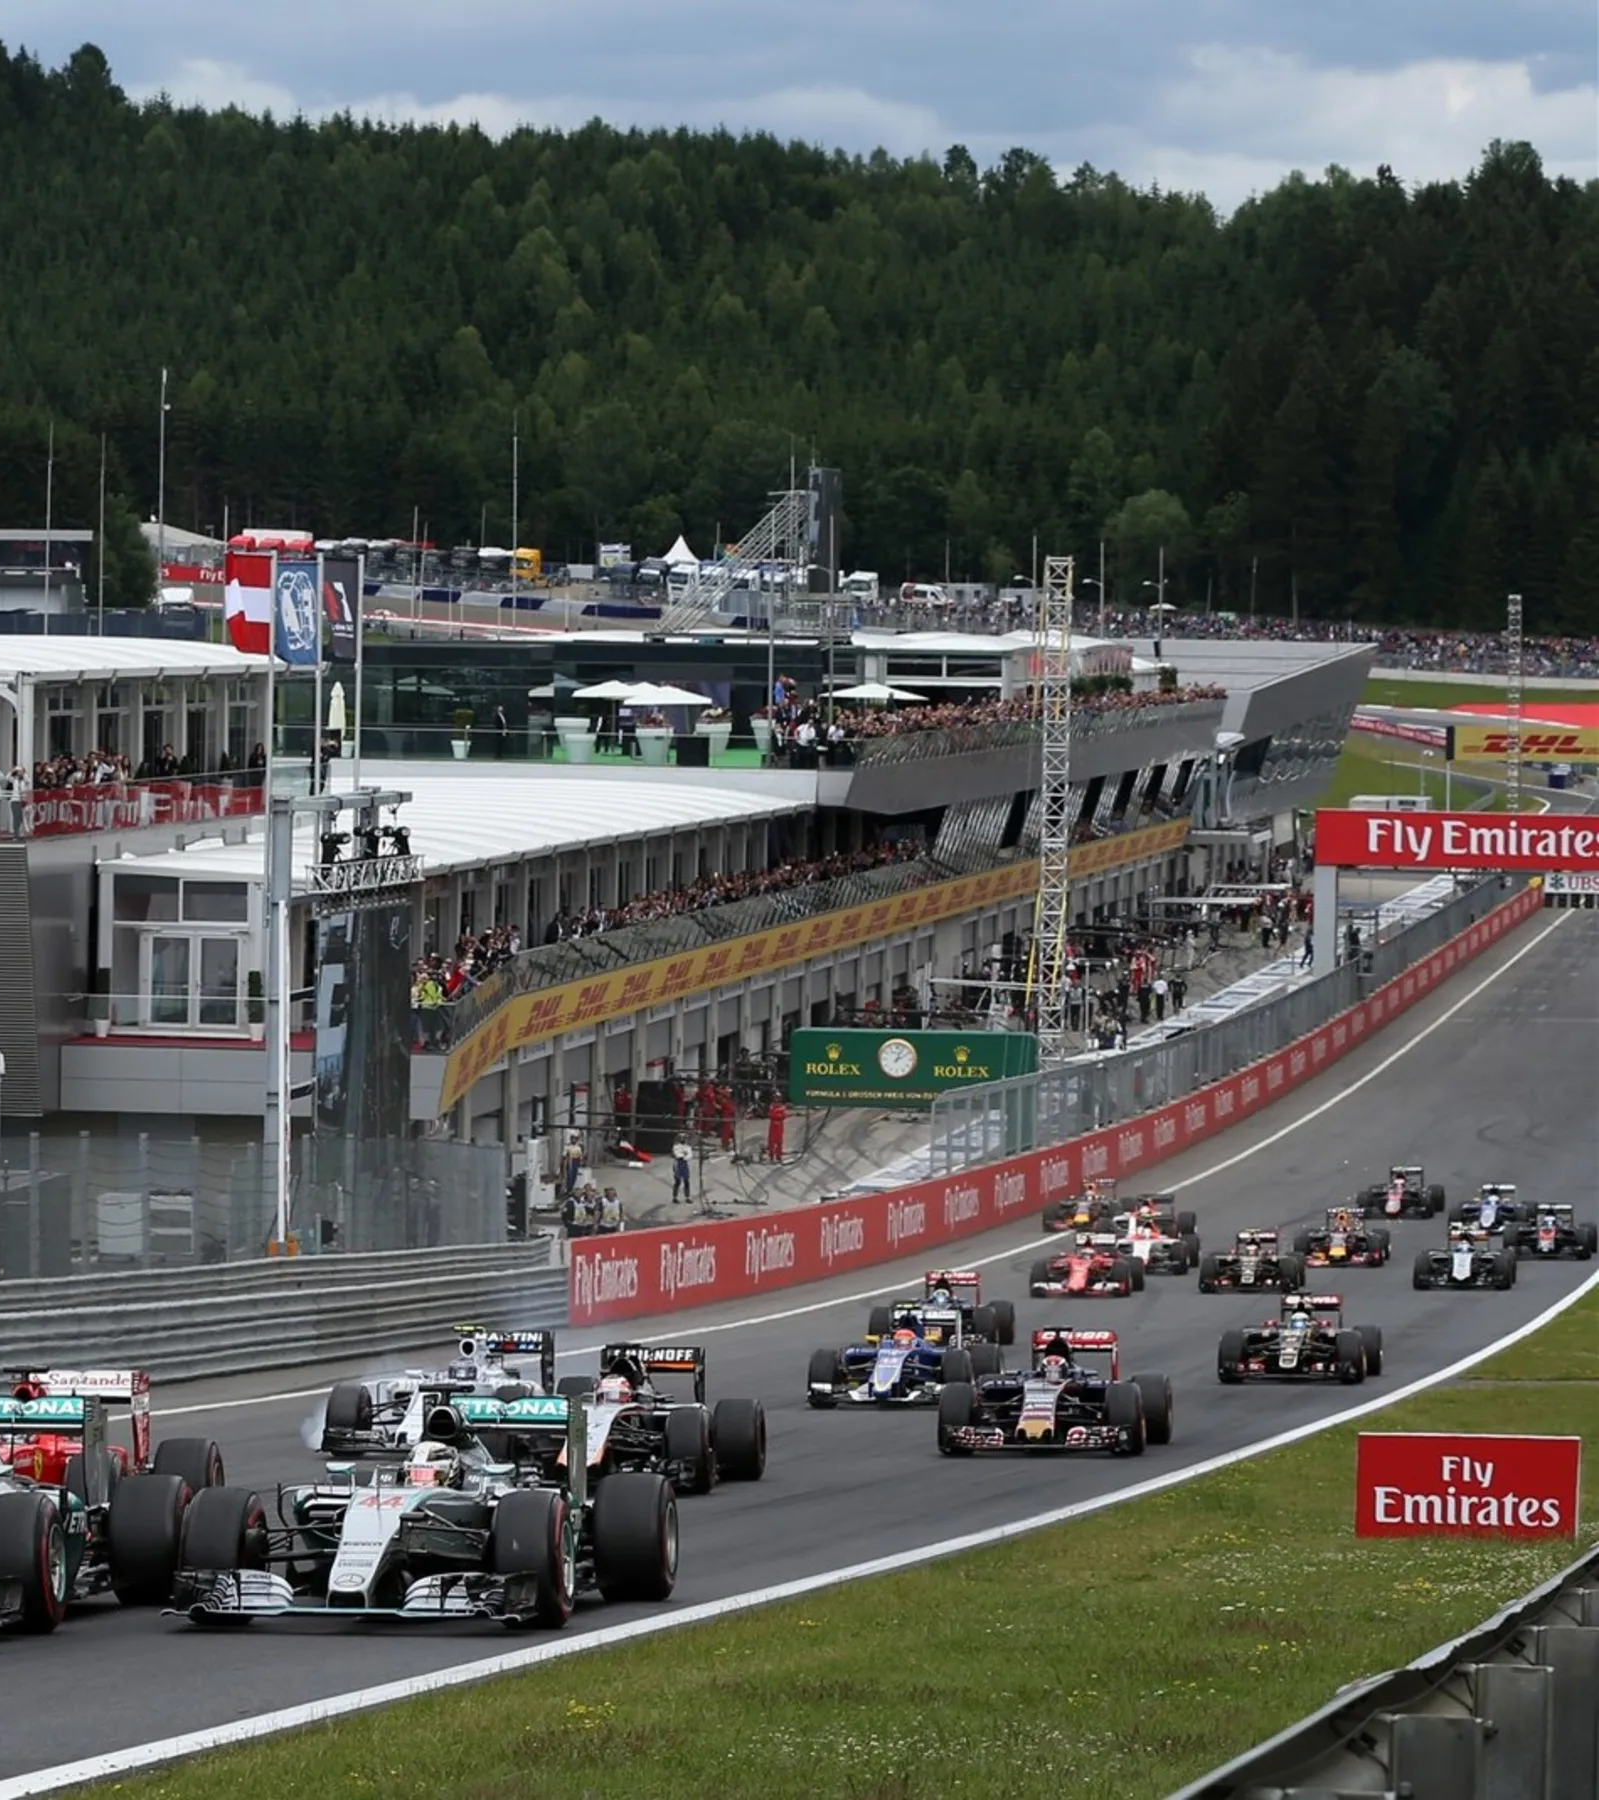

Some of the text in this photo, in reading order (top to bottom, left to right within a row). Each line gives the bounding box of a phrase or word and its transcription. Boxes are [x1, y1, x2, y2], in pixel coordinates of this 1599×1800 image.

[1483, 734, 1585, 754] DHL
[1367, 818, 1599, 862] Fly Emirate
[1568, 876, 1599, 891] UBS
[806, 1063, 861, 1076] ROLEX
[933, 1065, 989, 1078] ROLEX
[806, 1090, 841, 1098] FORMULA
[746, 1224, 795, 1284] Fly Emirates
[660, 1238, 716, 1300] Fly Emirates
[575, 1247, 638, 1315] Fly Emirates
[50, 1373, 130, 1386] Santande
[456, 1400, 568, 1416] ETRONAS
[1441, 1456, 1494, 1488] Fly
[1373, 1486, 1560, 1527] Emirates
